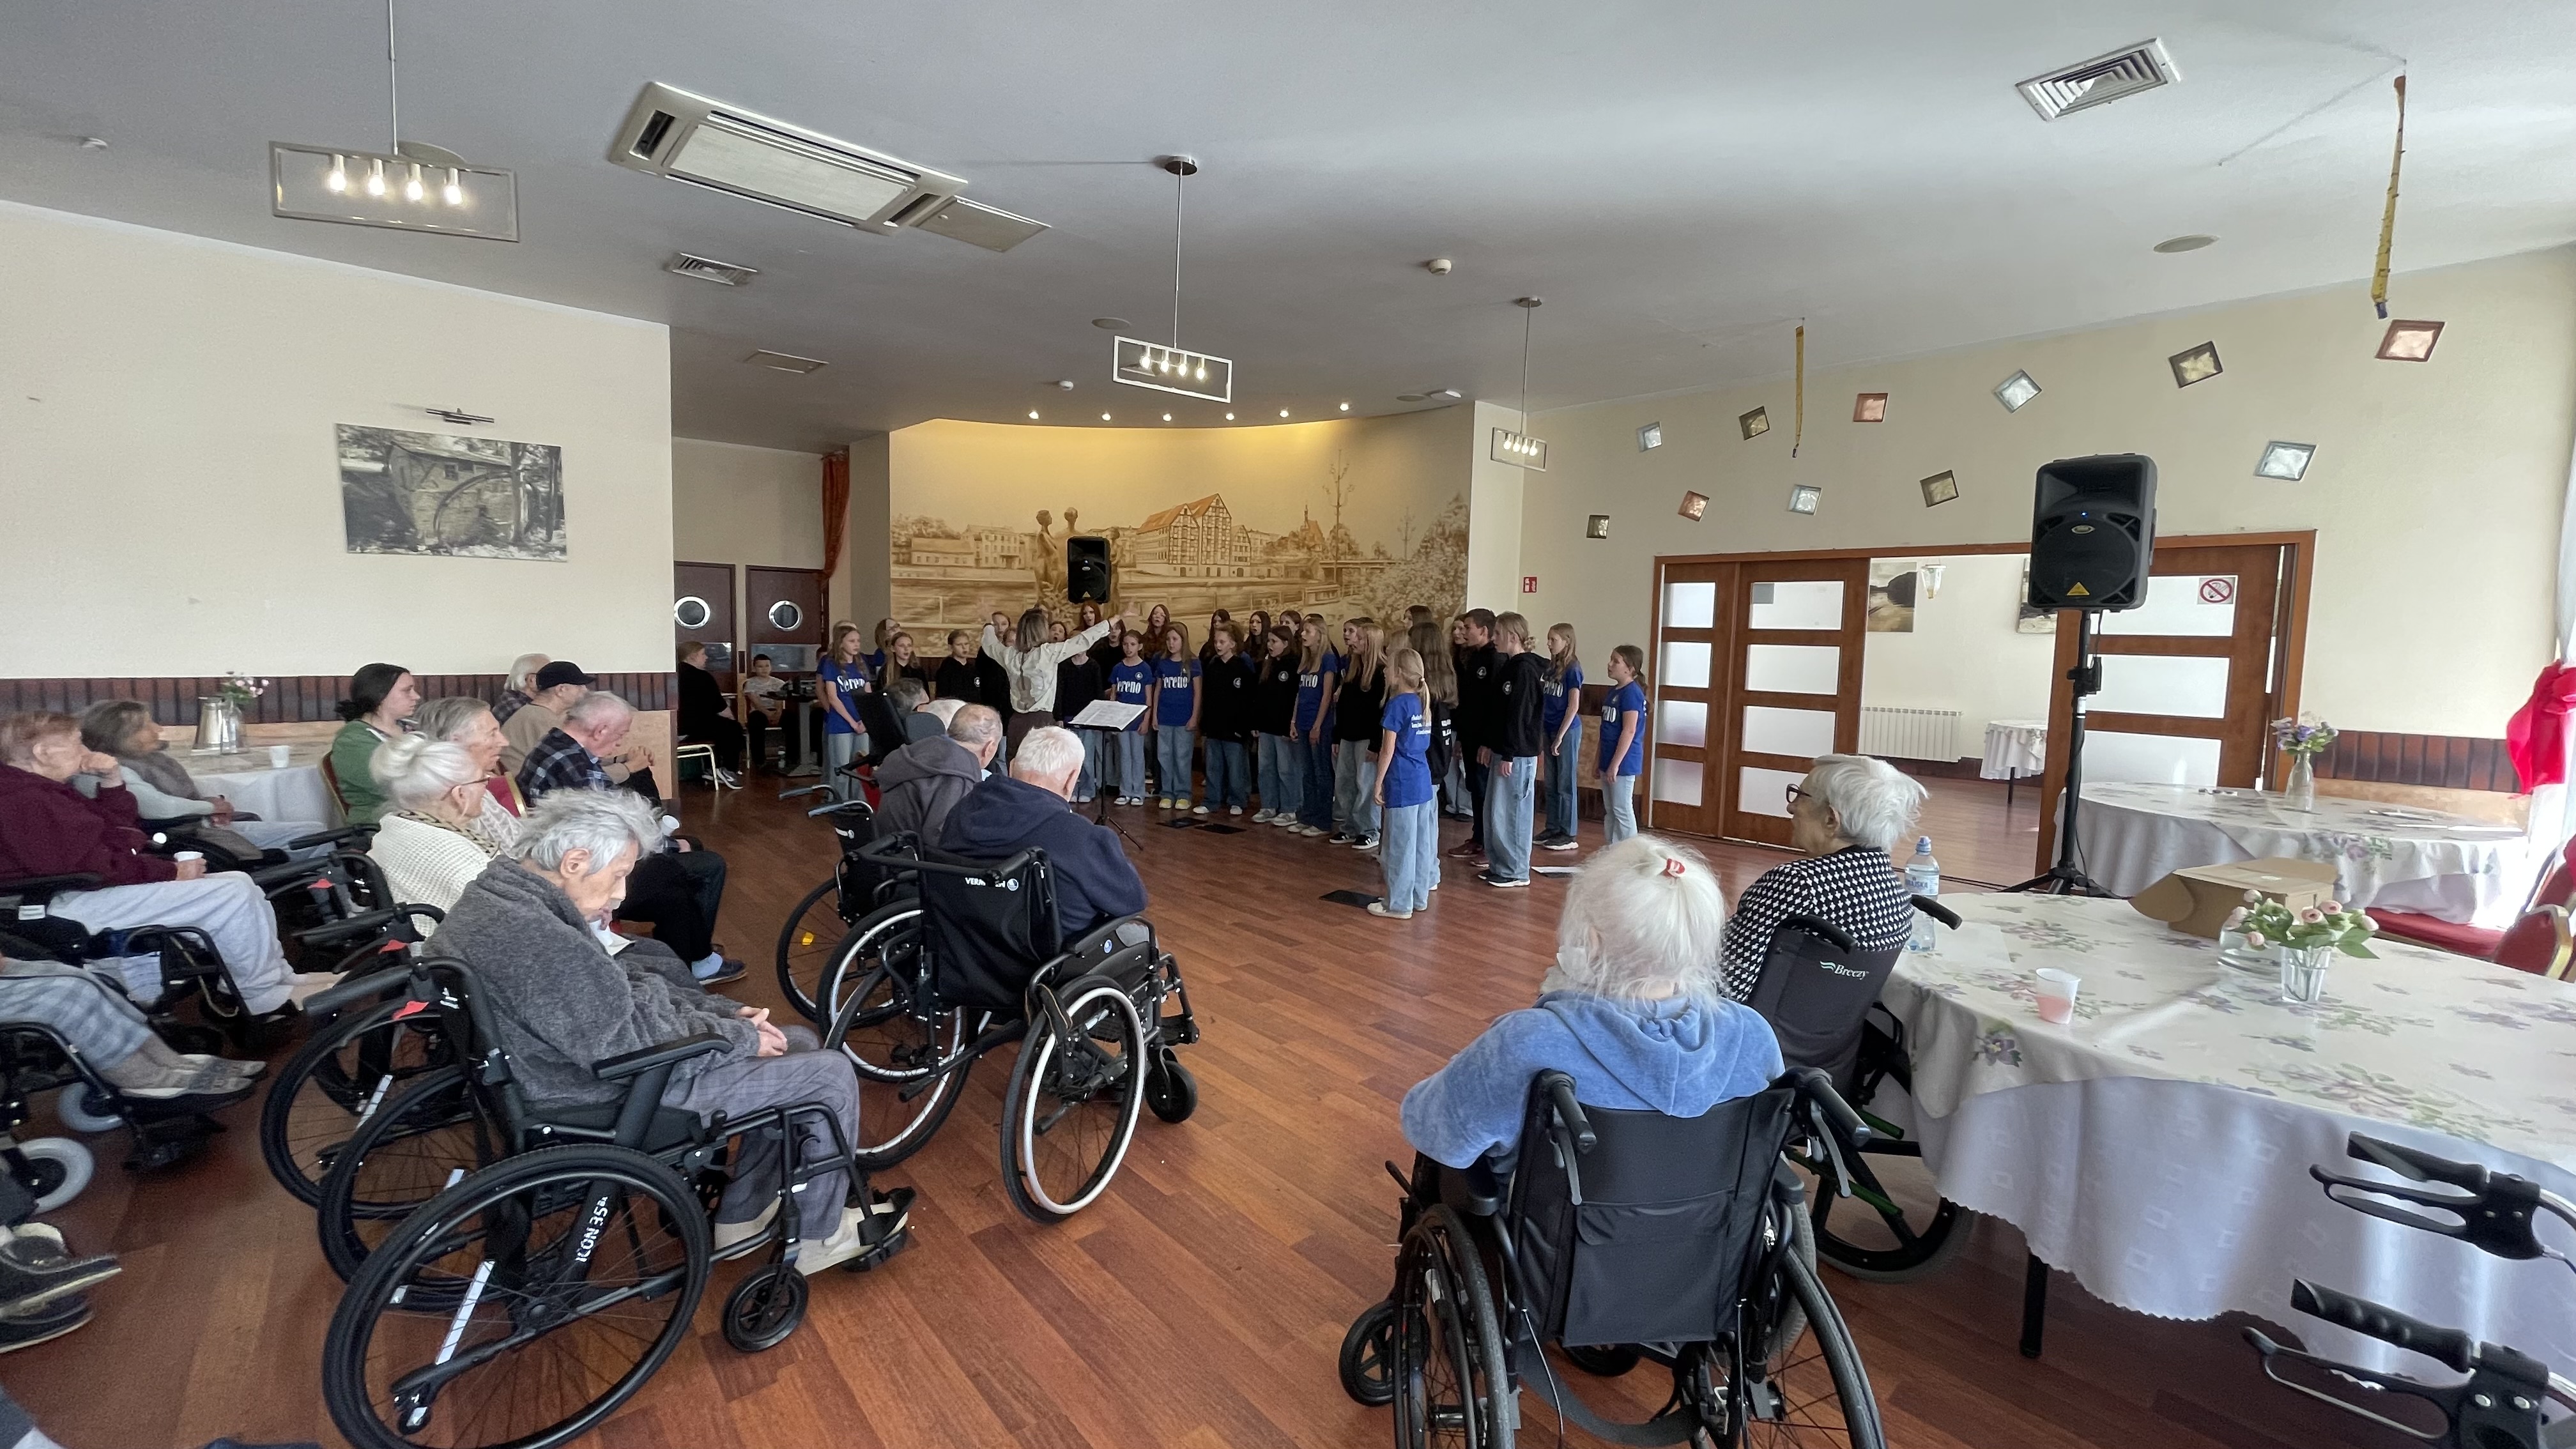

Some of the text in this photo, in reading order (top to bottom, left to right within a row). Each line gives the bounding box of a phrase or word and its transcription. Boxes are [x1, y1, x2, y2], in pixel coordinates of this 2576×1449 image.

[1116, 677, 1142, 694] ereno
[1163, 674, 1188, 689] ereno
[1834, 963, 1866, 981] Breezy
[575, 1227, 600, 1262] ICON
